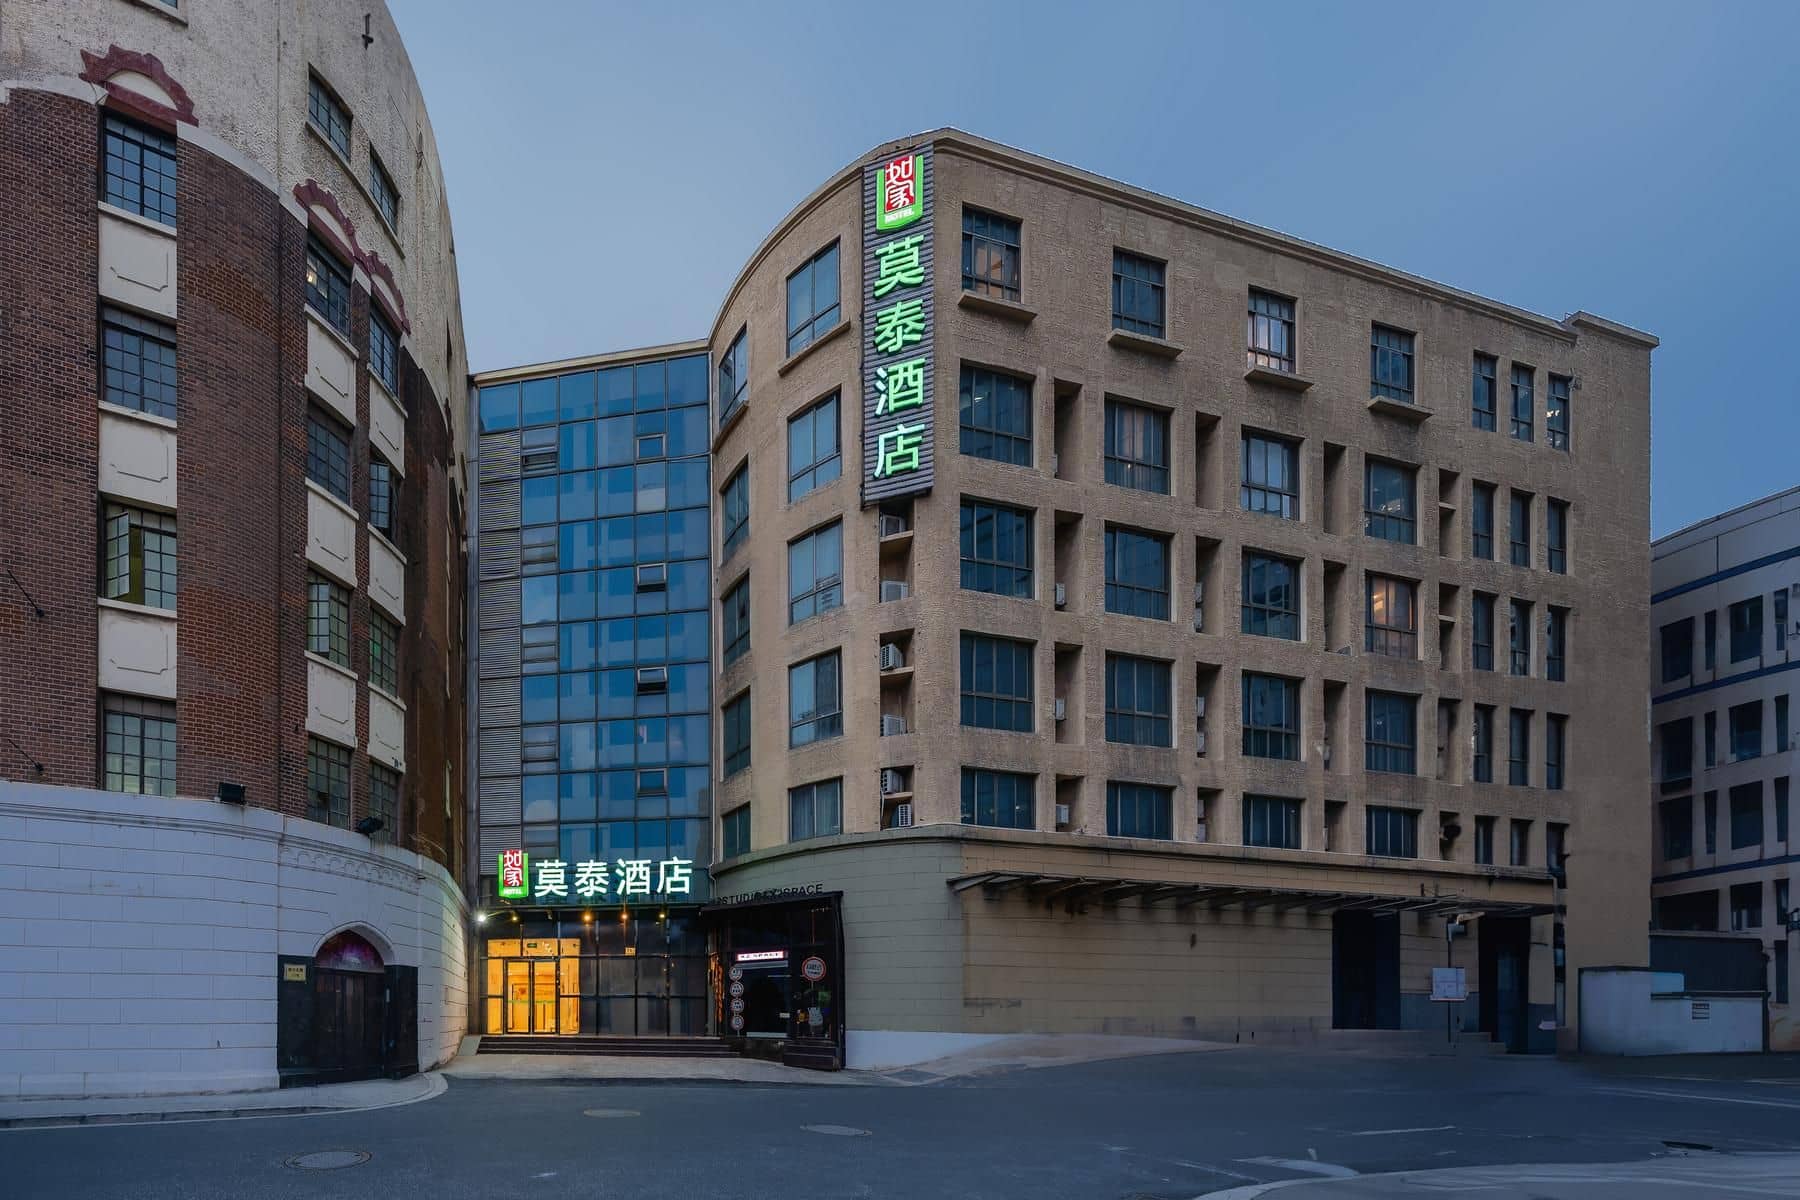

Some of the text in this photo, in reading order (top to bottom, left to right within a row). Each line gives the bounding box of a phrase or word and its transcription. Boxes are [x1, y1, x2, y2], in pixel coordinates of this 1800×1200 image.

[874, 234, 925, 476] 莫泰酒店
[534, 856, 693, 898] 莫泰酒店
